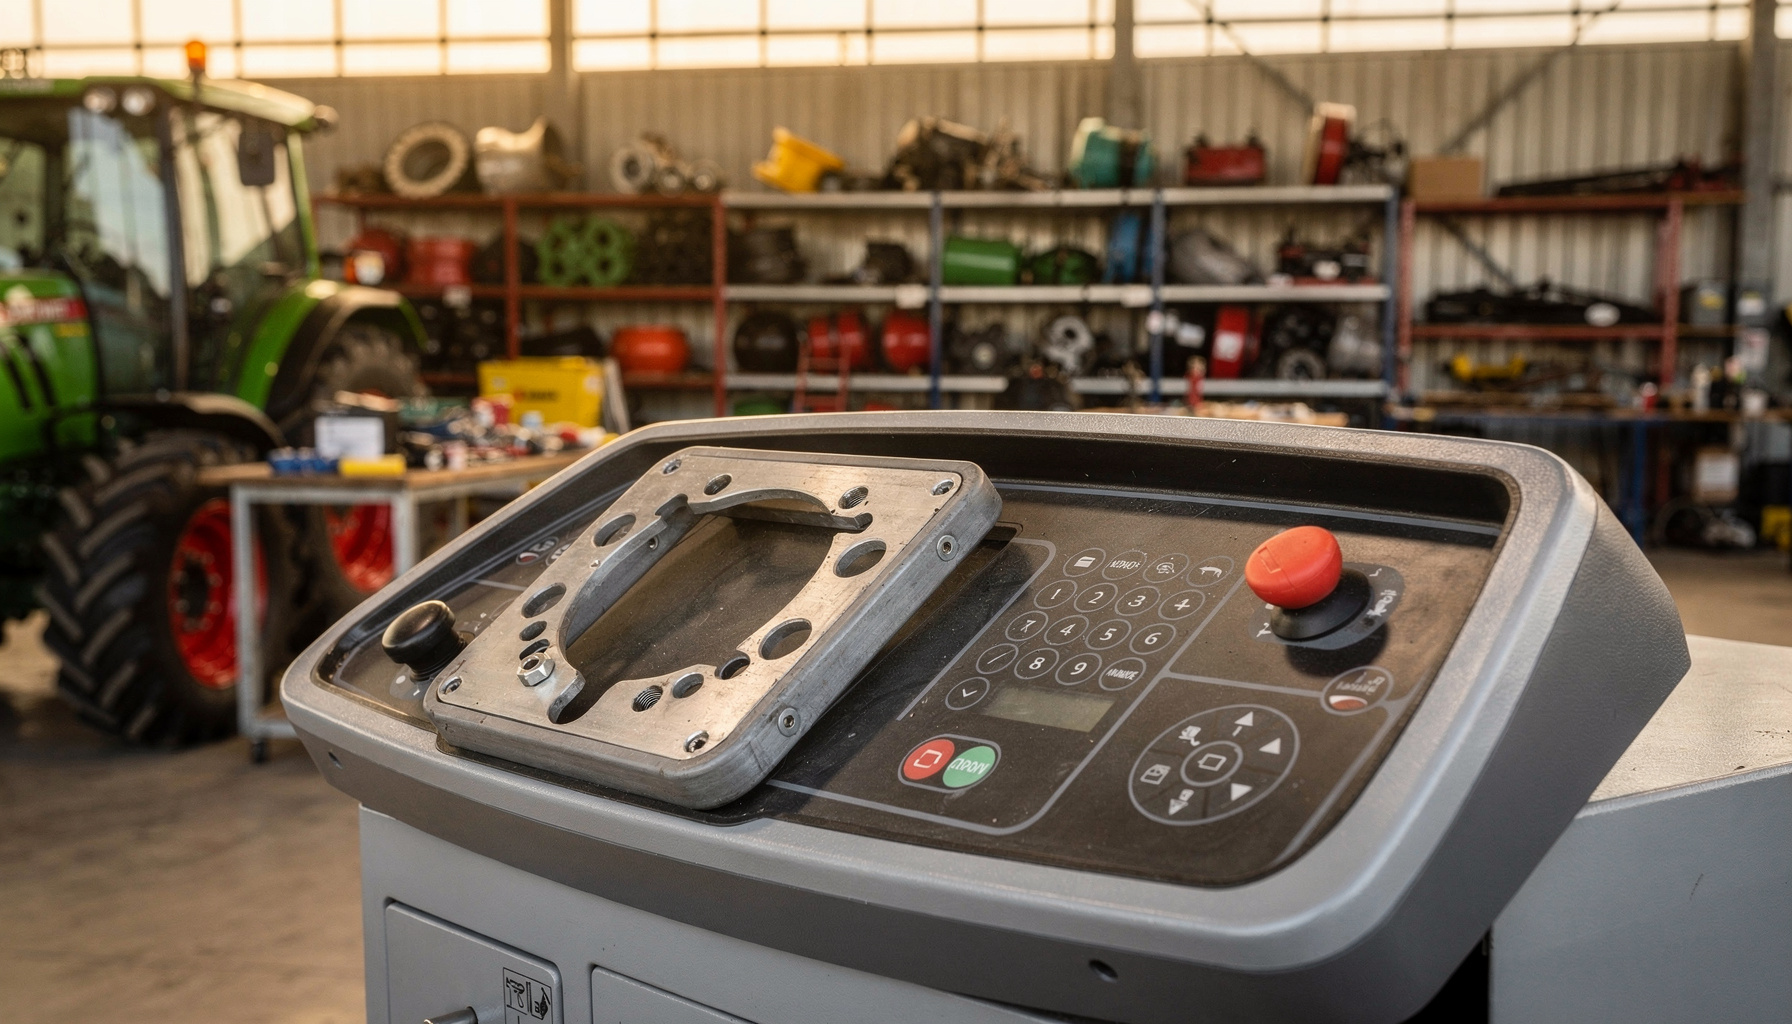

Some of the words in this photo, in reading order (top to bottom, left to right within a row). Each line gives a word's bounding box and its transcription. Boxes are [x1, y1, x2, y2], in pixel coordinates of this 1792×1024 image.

[1050, 588, 1062, 600] 1
[1088, 591, 1104, 604] 2
[1127, 595, 1146, 607] 3
[1059, 623, 1076, 636] 4
[1099, 627, 1118, 641] 5
[1144, 632, 1162, 645] 6
[1028, 656, 1046, 670] 8
[1070, 662, 1088, 676] 9
